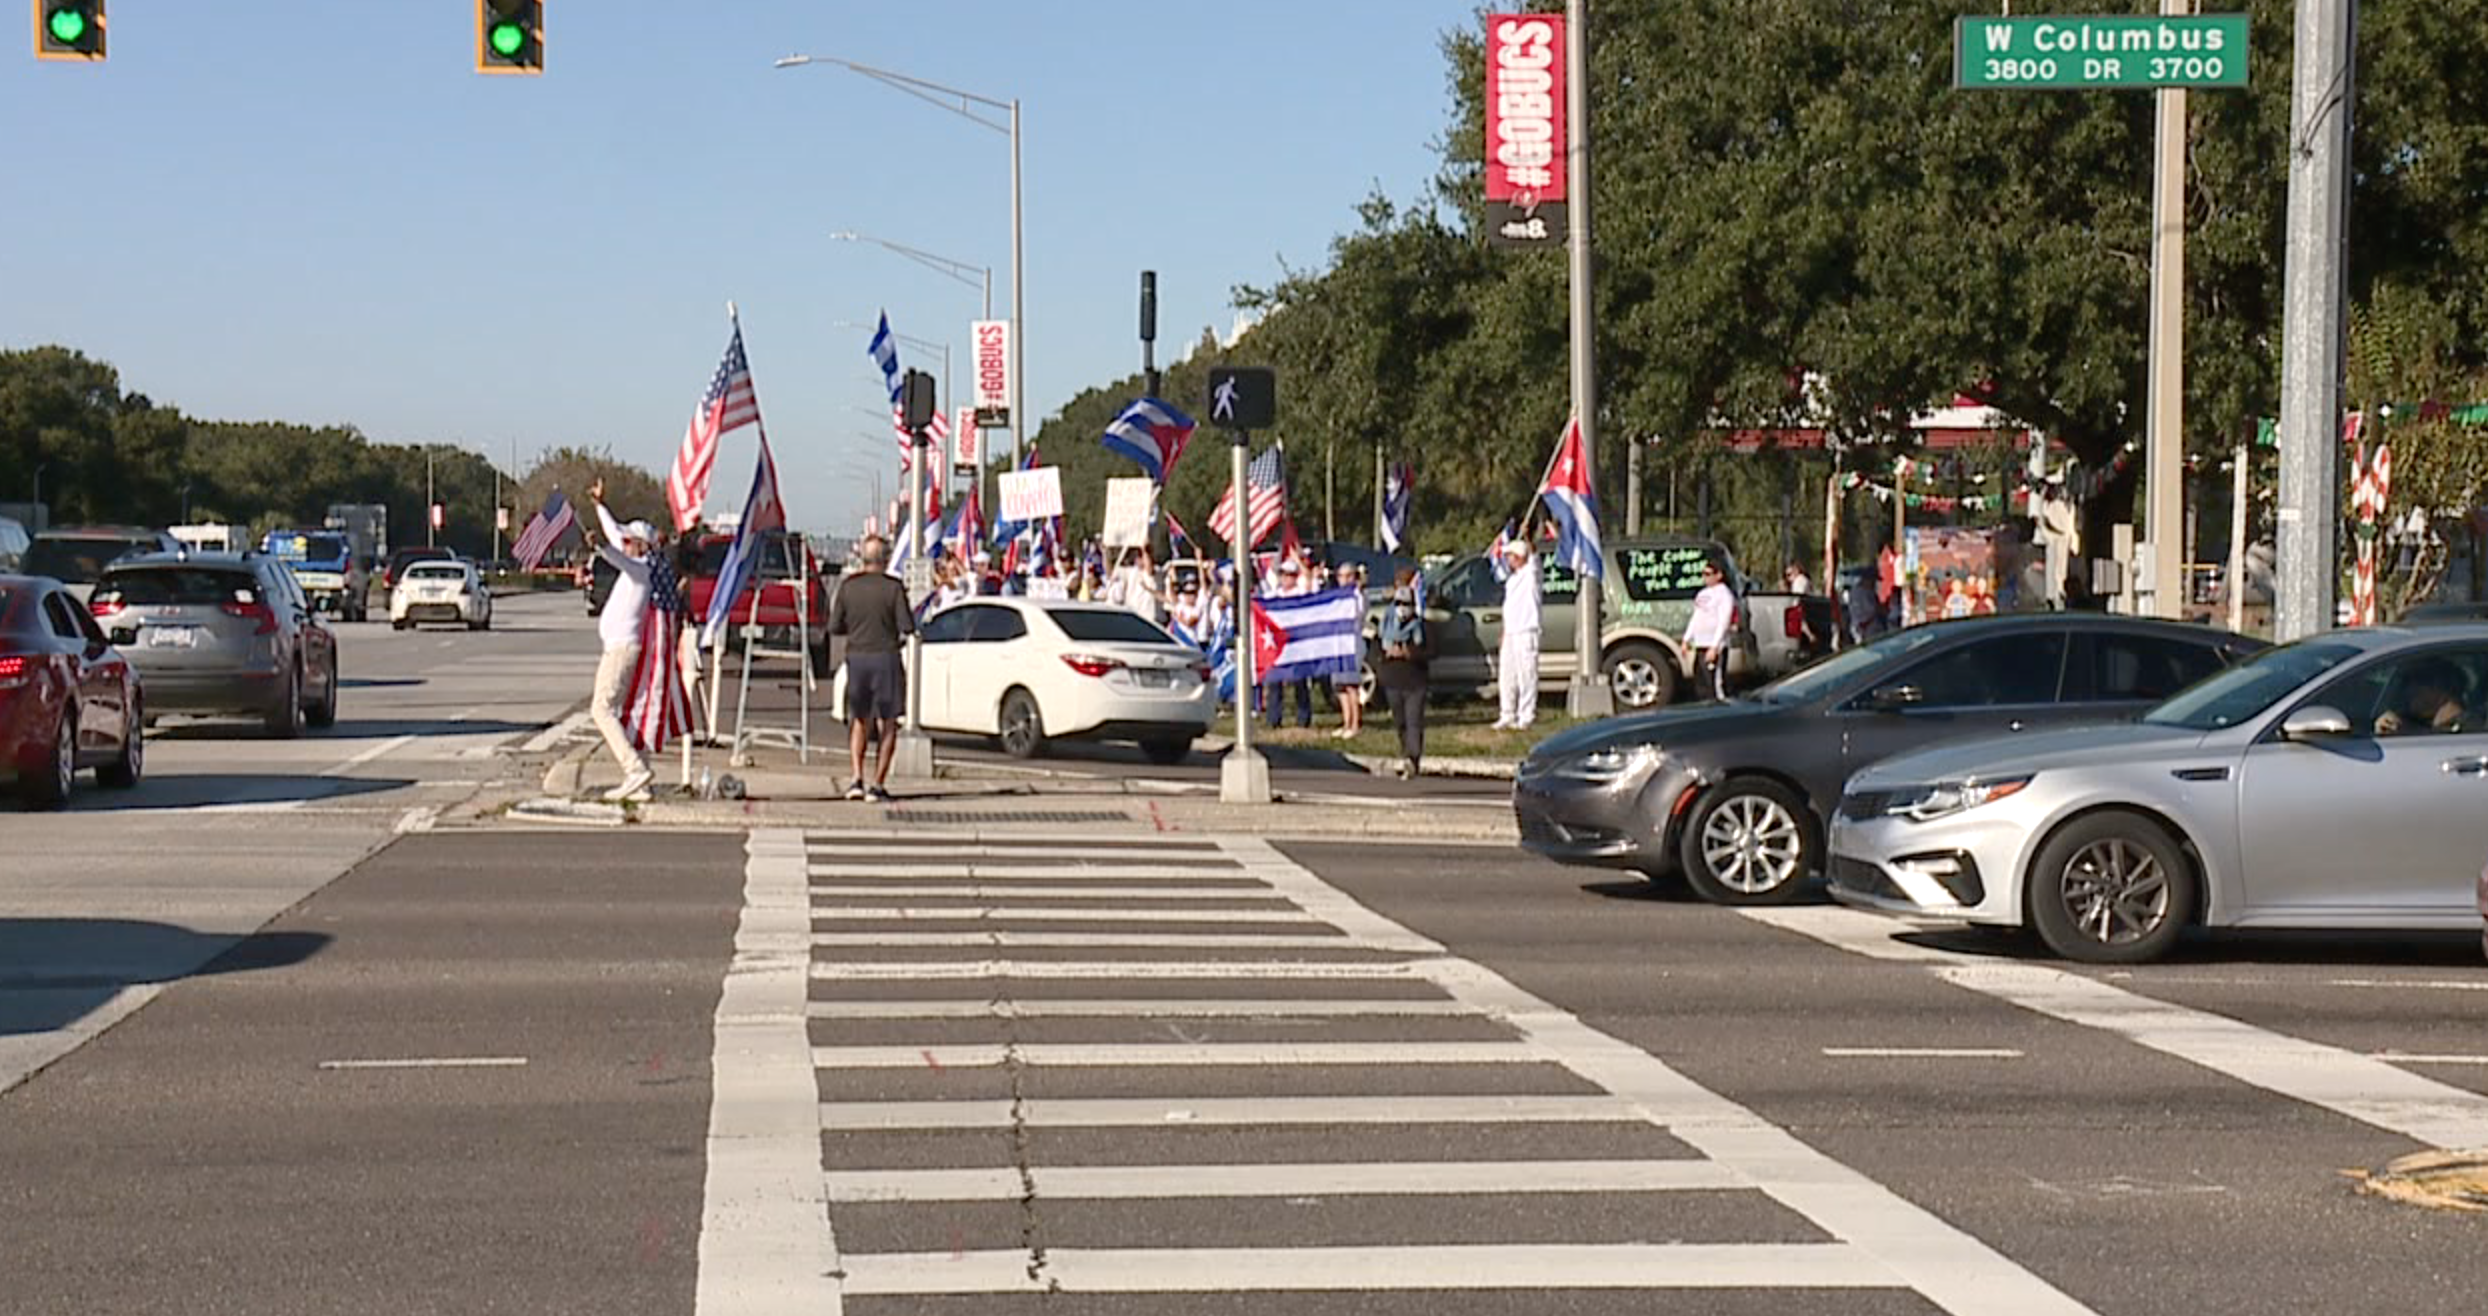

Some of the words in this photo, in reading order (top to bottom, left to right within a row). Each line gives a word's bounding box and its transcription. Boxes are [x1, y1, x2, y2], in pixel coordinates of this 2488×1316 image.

[1985, 24, 2012, 51] W
[2033, 23, 2224, 51] Columbus
[1985, 58, 2057, 80] 3800
[2083, 58, 2121, 79] DR
[2149, 57, 2223, 80] 3700
[1497, 20, 1553, 187] #GOBUCS
[978, 325, 1004, 400] #GOBUCS
[1628, 550, 1656, 566] The
